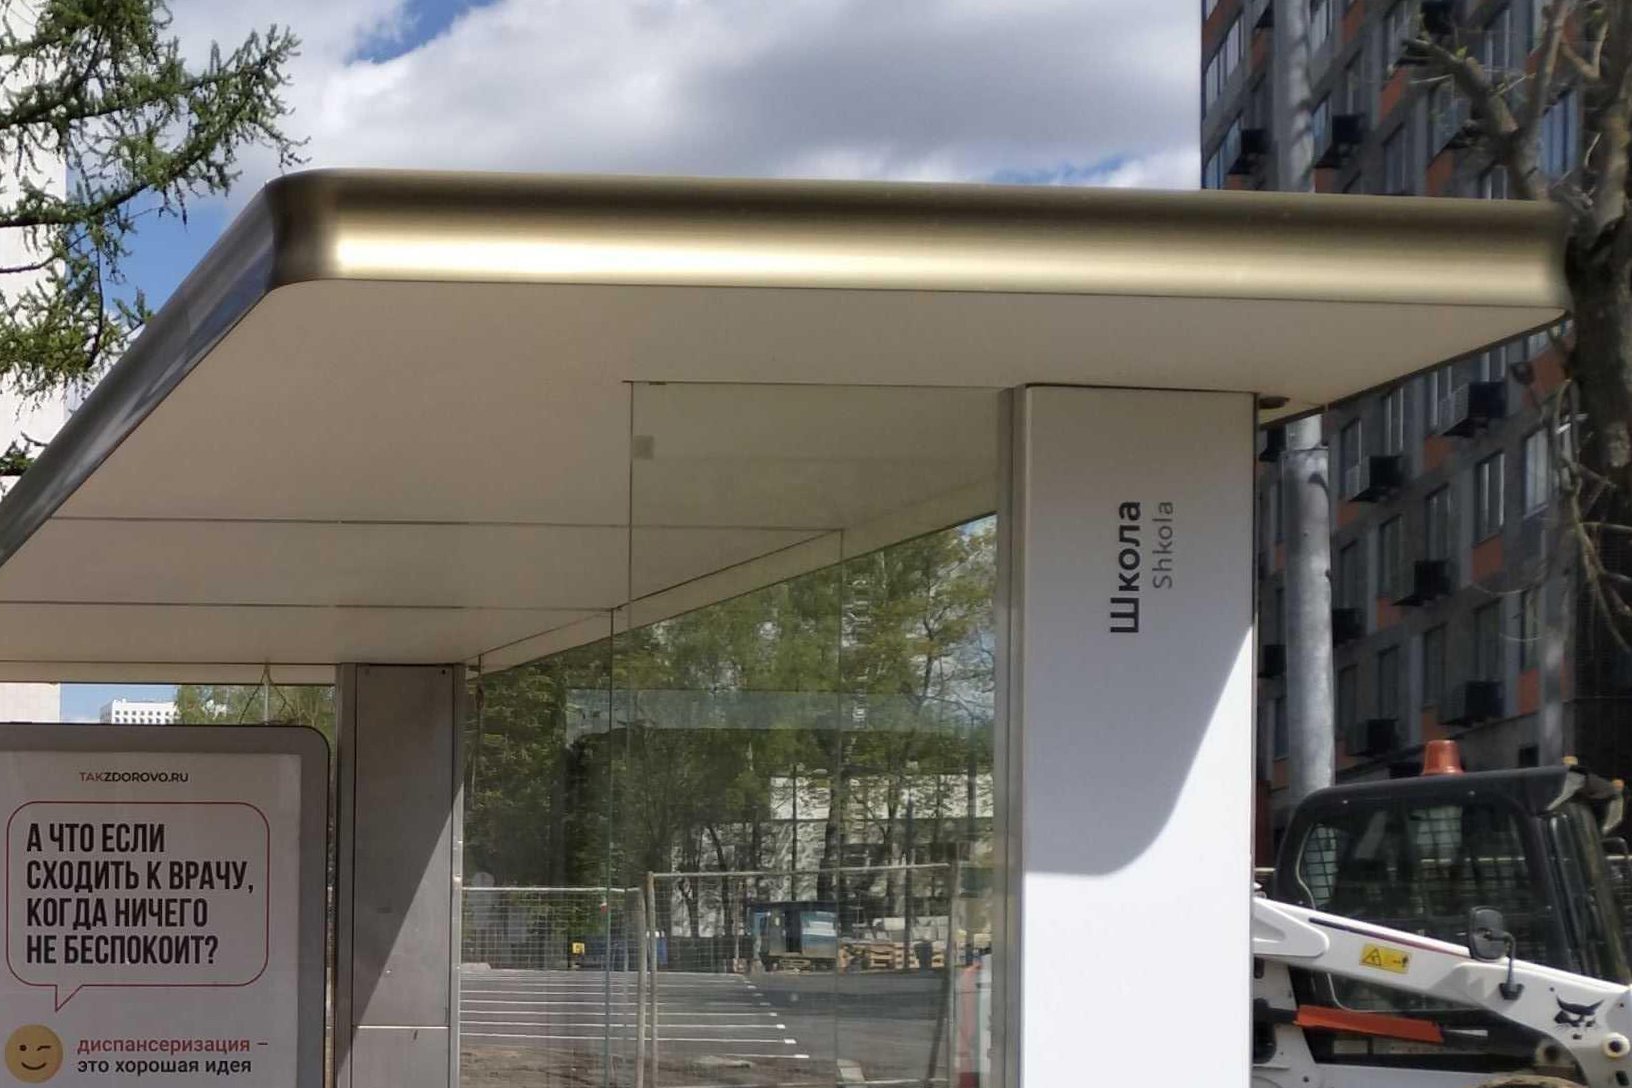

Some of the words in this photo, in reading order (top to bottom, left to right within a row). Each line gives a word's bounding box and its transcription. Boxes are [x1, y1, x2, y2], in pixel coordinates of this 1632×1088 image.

[1152, 501, 1173, 589] Shkola
[1110, 501, 1140, 633] Школа
[79, 772, 189, 783] TAKZDOROVO.RU
[26, 823, 42, 852] А
[49, 823, 94, 852] ЧТО
[102, 823, 165, 852] ЕСЛИ
[26, 860, 139, 892] СХОДИТЬ
[147, 861, 161, 889] К
[169, 861, 254, 893] ВРАЧУ,
[26, 898, 107, 930] КОГДА
[115, 898, 207, 927] НИЧЕГО
[26, 935, 57, 964] НЕ
[64, 935, 218, 964] БЕСПОКОИТ?
[77, 1039, 250, 1055] диспансеризация
[77, 1060, 109, 1073] это
[115, 1060, 199, 1076] хорошая
[205, 1060, 252, 1075] идея
